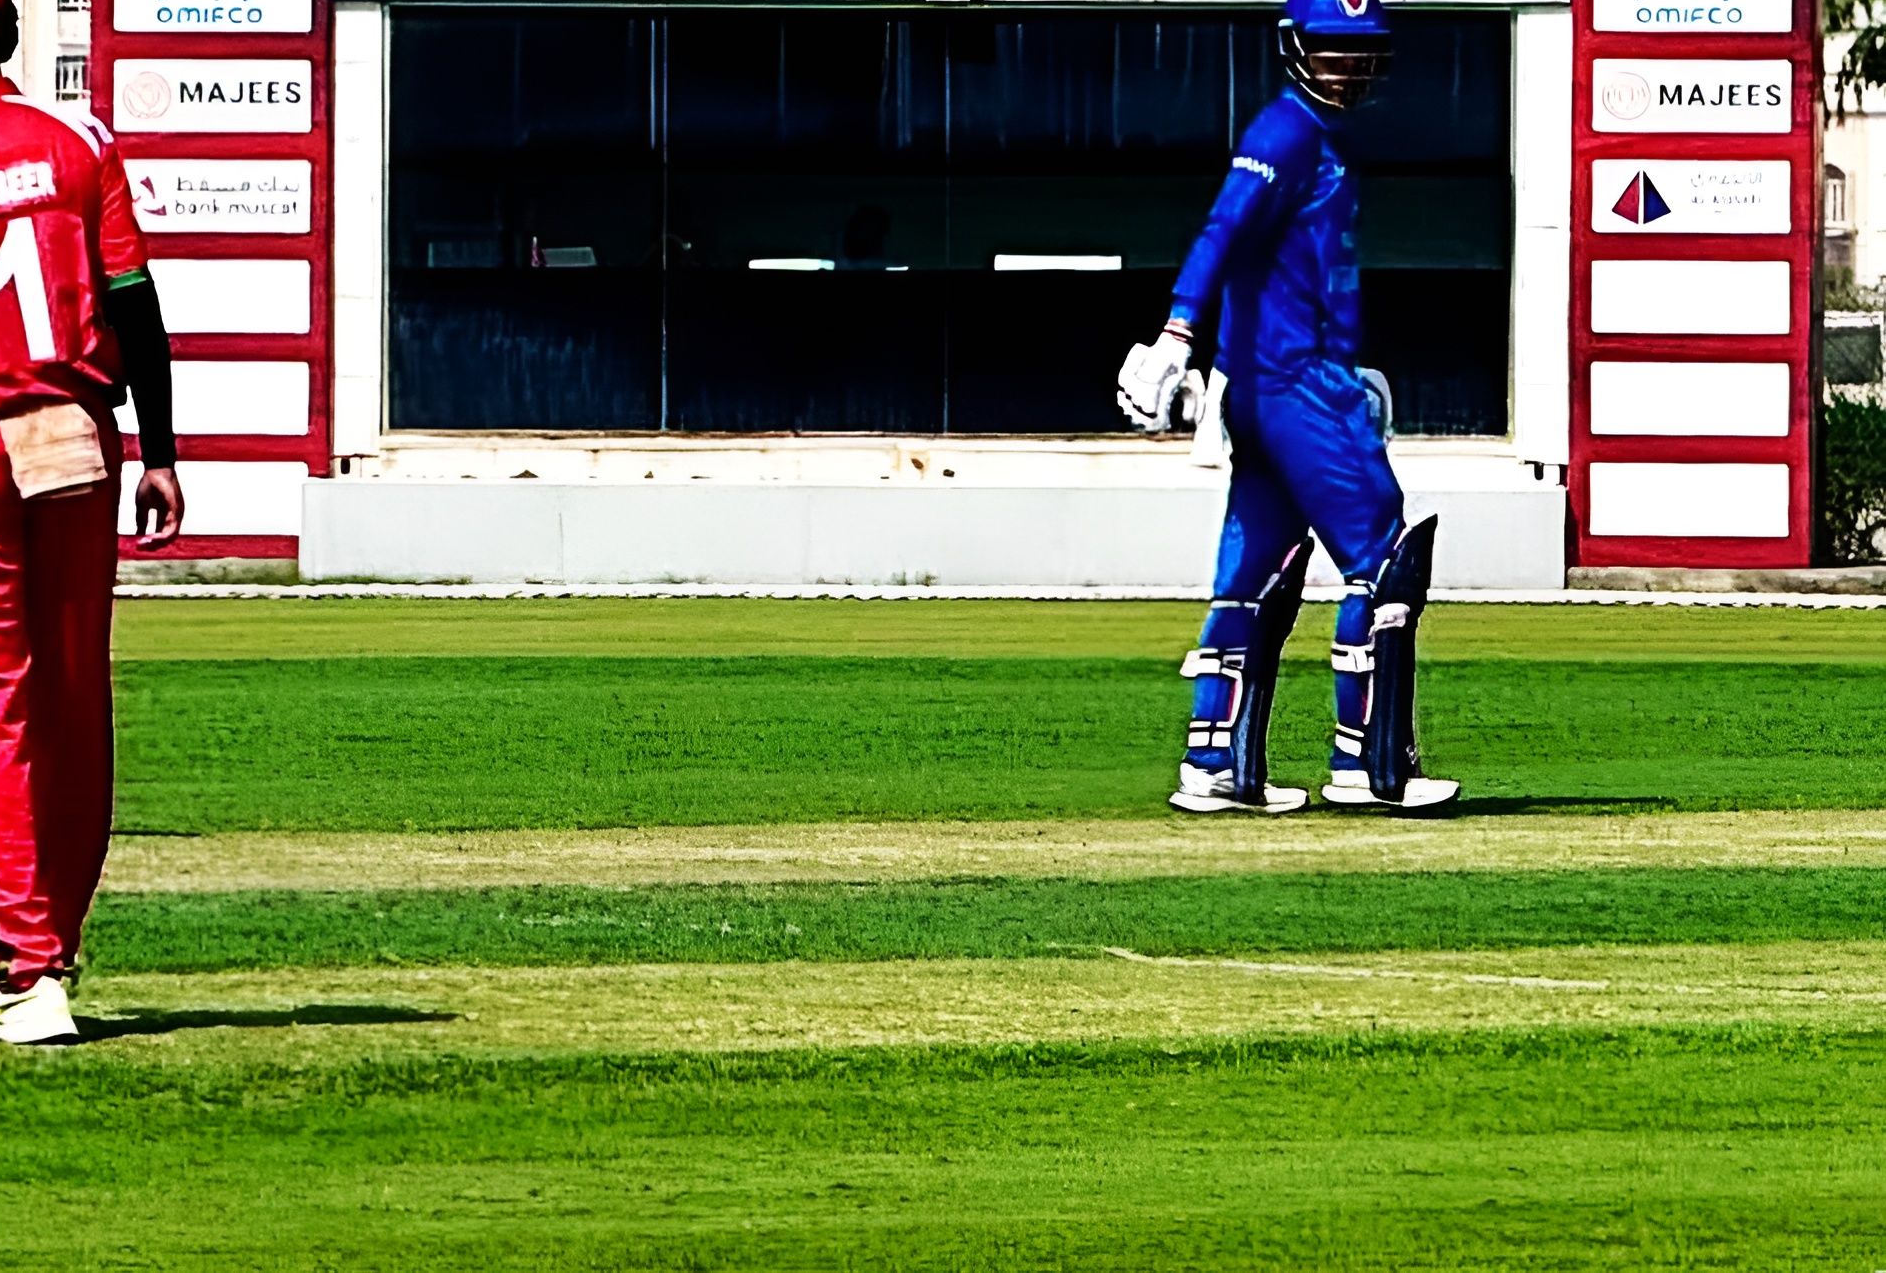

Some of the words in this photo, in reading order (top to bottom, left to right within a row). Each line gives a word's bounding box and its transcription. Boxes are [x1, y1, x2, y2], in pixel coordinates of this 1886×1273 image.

[155, 5, 264, 25] OMIFCO
[1635, 5, 1744, 26] OMIFCO
[178, 80, 302, 105] MAJEES
[1658, 82, 1783, 108] MAJEES
